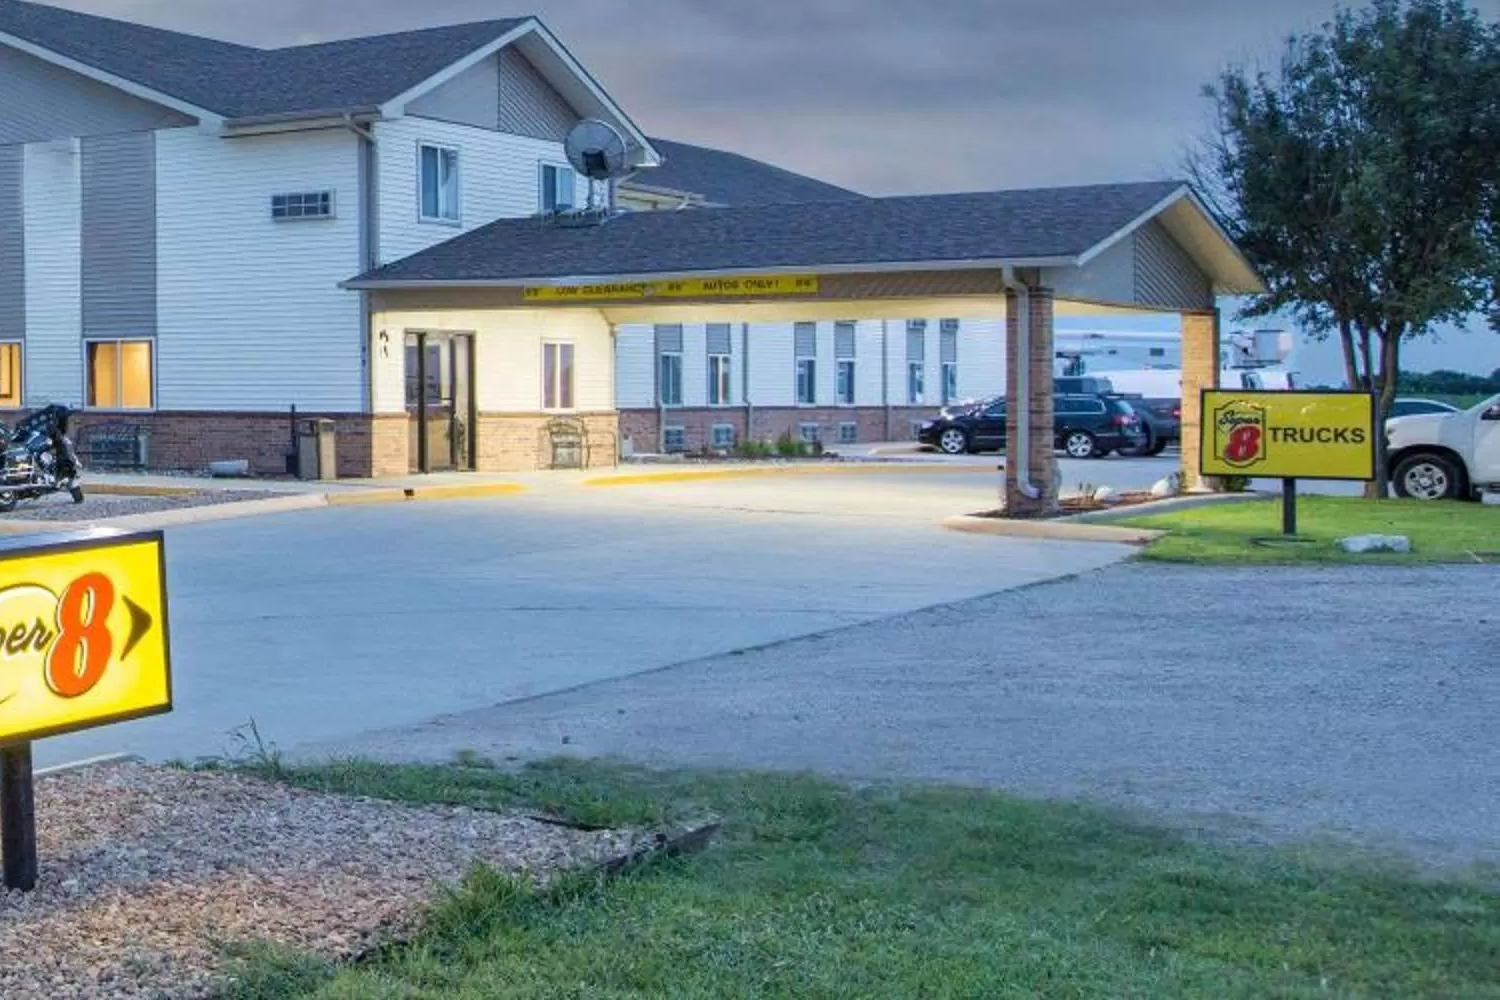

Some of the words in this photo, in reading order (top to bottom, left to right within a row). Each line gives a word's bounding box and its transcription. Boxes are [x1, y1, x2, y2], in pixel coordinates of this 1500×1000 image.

[1219, 410, 1260, 427] Super
[1223, 424, 1262, 463] 8
[1268, 427, 1366, 443] TRUCKS
[45, 572, 115, 698] 8
